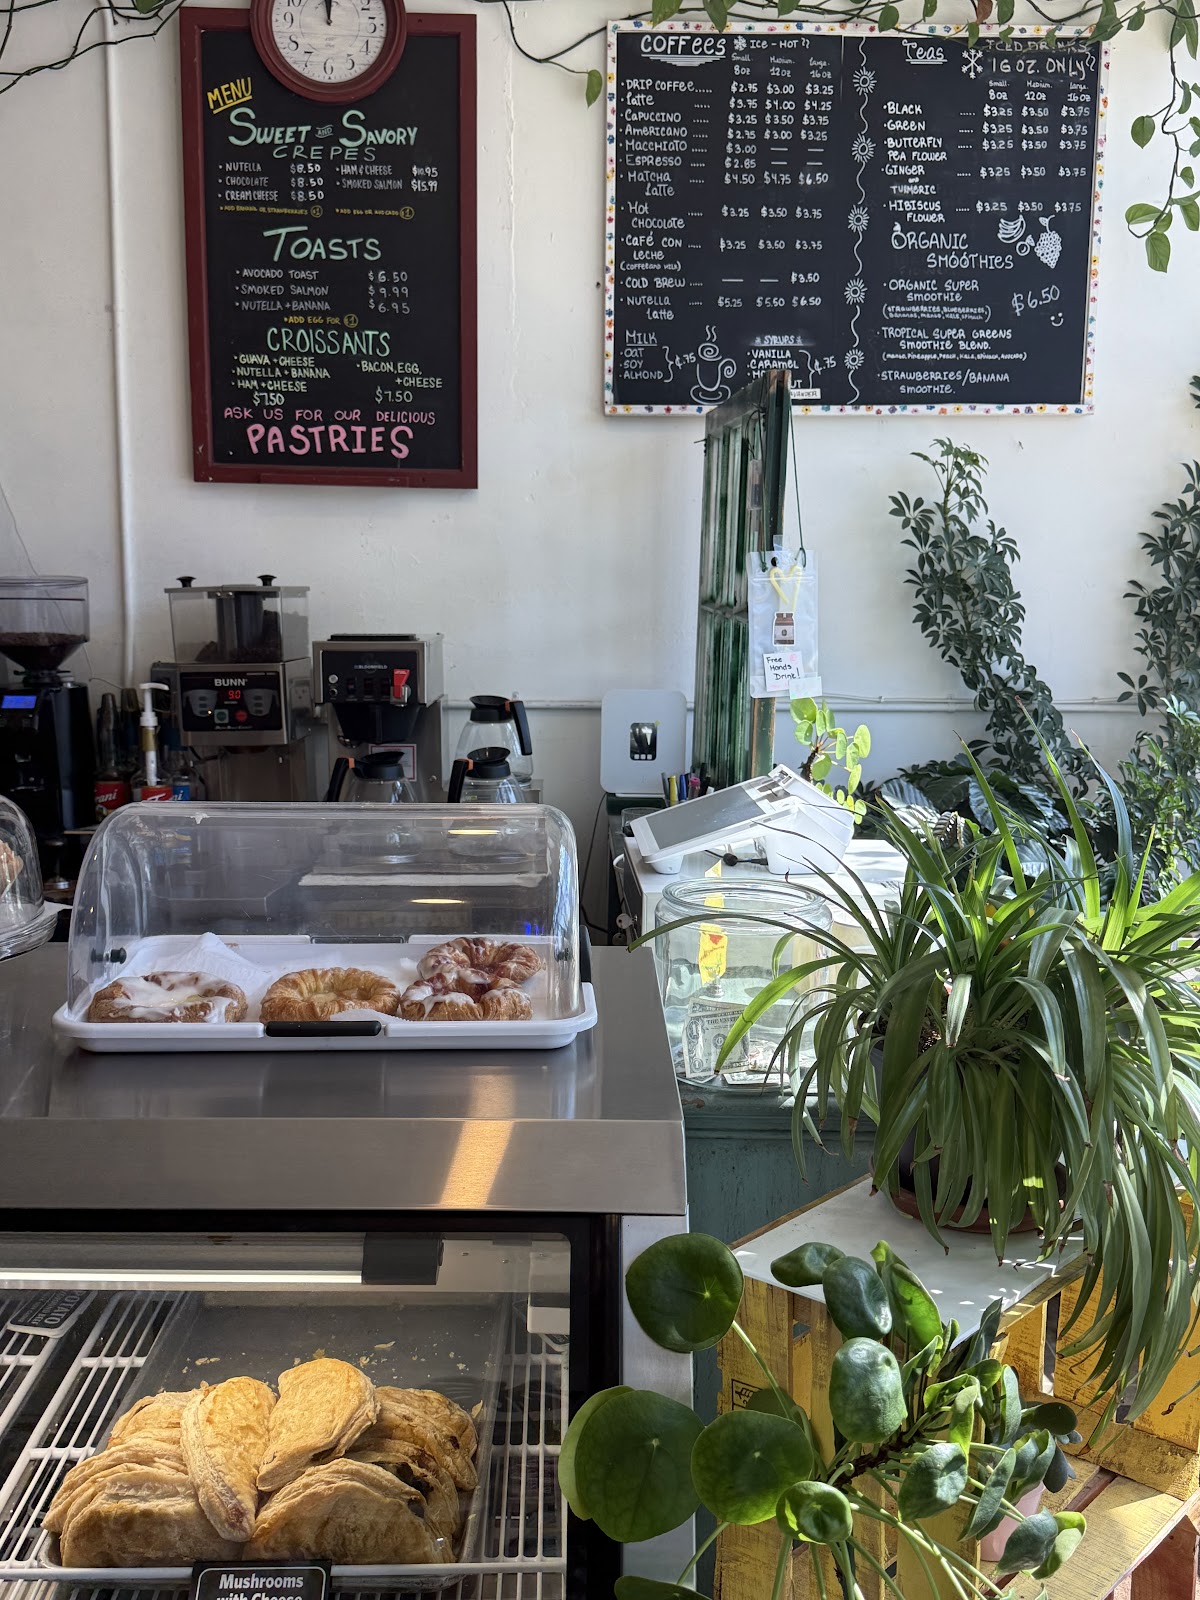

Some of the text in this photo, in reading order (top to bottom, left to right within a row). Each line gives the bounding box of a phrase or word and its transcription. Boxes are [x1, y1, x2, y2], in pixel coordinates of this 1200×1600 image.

[284, 12, 294, 29] 9
[368, 17, 377, 34] 3
[288, 34, 299, 51] 8
[360, 40, 371, 55] 4
[304, 51, 314, 67] 7
[346, 54, 355, 70] 5
[324, 58, 334, 75] 6
[207, 77, 252, 110] MENU
[626, 79, 833, 95] DRIP $2.75 $3.00 $3.25
[765, 99, 795, 110] $4.00
[805, 100, 832, 110] $4.25
[887, 102, 1089, 117] BLACK $3.25 $3.50 $3.75
[728, 113, 829, 125] $3.25 $3.50 $3.75
[728, 128, 827, 141] $2.75 $3.00 $3.25
[982, 122, 1087, 135] $3.25 $3.50 $3.75
[726, 142, 756, 154] $3.00
[983, 139, 1013, 151] $3.25
[1022, 140, 1047, 151] $3.50
[1060, 140, 1086, 150] $3.75
[273, 145, 375, 161] CREPES
[226, 162, 261, 171] NUTELLA
[291, 163, 320, 174] $8.50
[341, 165, 357, 175] HAM
[365, 165, 392, 175] CHEESE
[980, 166, 1086, 179] $3.25 $3.50 $3.75
[226, 176, 437, 191] CHOCOLATE $8.50 SMOKED SALMON $15.99
[725, 171, 828, 185] $4.50 $4.75 $6.50
[226, 190, 324, 201] CREAM CHEESE $8.50
[722, 205, 749, 217] $3.25
[761, 206, 787, 217] $3.50
[796, 207, 822, 218] $3.75
[976, 201, 1007, 213] $3.25
[1018, 201, 1043, 212] $3.50
[1055, 202, 1081, 212] $3.75
[720, 238, 746, 252] $3.25
[758, 240, 785, 249] $3.50
[796, 240, 822, 250] $3.75
[891, 231, 968, 249] ORGANIC
[243, 269, 283, 278] AVOCADO
[289, 270, 319, 279] TOAST
[791, 272, 819, 284] $3.50
[241, 284, 284, 295] SMOKED
[290, 285, 328, 295] SALMON
[718, 296, 821, 307] $5.25 $5.50 $6.50
[889, 279, 1060, 316] ORGANIC $6.50
[242, 301, 283, 310] NUTELLA
[626, 330, 658, 344] MILK
[882, 327, 929, 338] TROPICAL
[268, 328, 390, 356] CROISSANTS
[240, 354, 270, 365] GUAVA
[752, 349, 791, 358] VANILLA
[624, 360, 643, 369] SOY
[237, 367, 282, 377] NUTELLA
[624, 371, 663, 379] ALMOND
[238, 380, 258, 389] HAM
[253, 391, 284, 406] $7.50
[375, 386, 412, 403] $7.50
[224, 407, 435, 425] ASK US FOR OUR DELICIOUS
[247, 424, 413, 458] PASTRIES
[219, 1573, 304, 1589] Mushrooms
